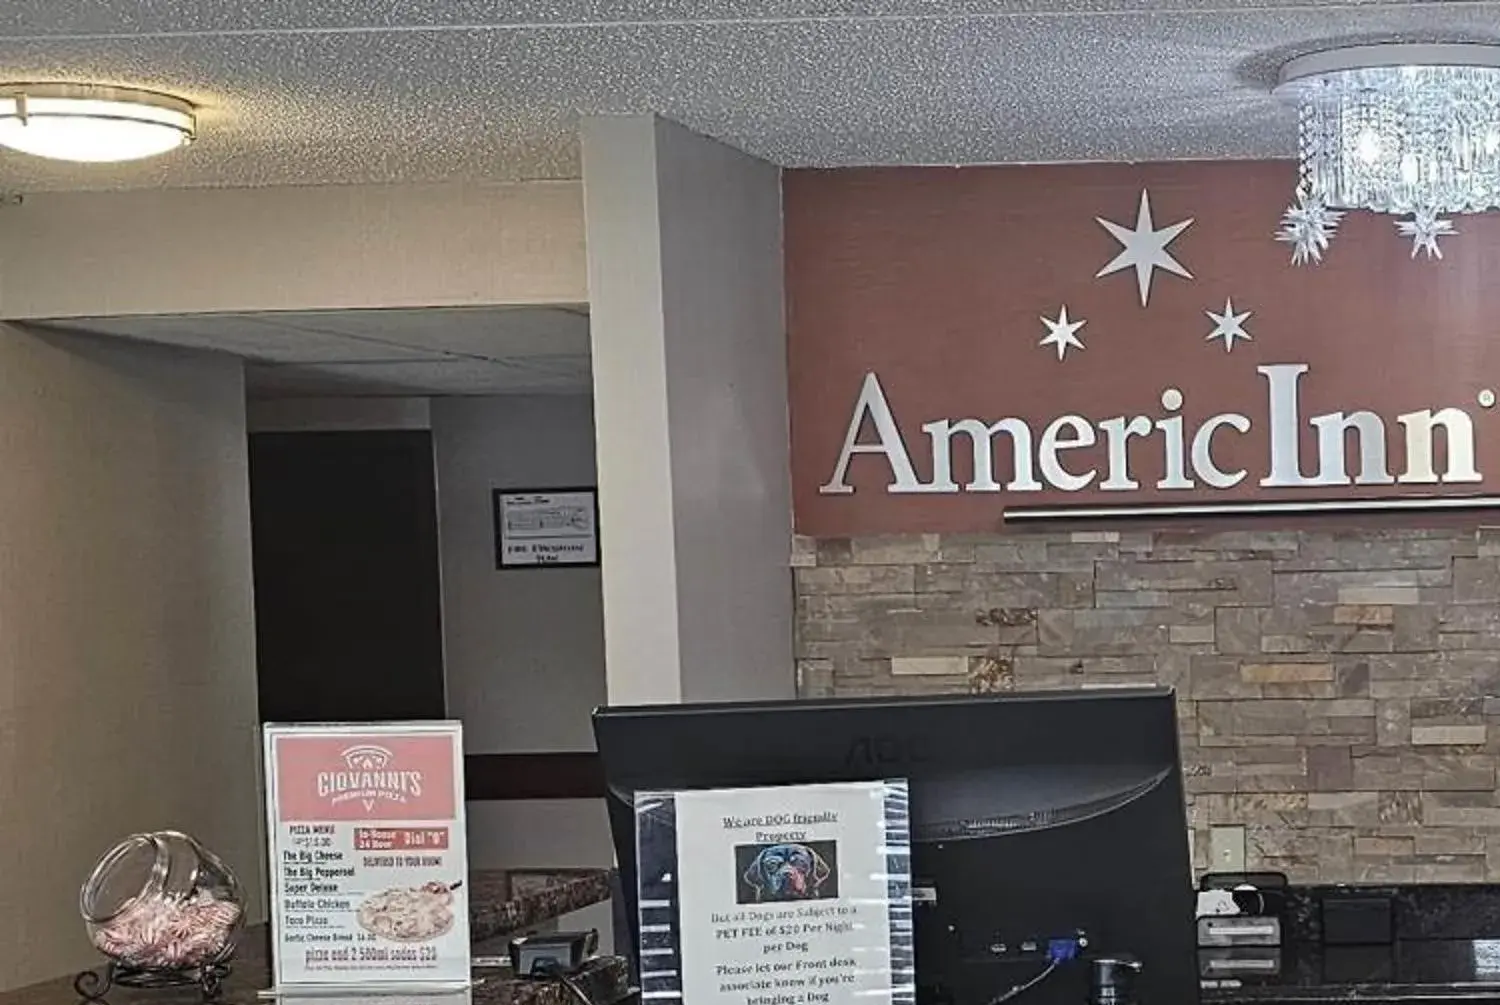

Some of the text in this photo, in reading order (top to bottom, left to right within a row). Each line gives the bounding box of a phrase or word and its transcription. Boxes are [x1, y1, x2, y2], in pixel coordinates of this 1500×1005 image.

[819, 363, 1484, 493] AmericInn
[317, 770, 421, 797] GIOVANNI'S
[743, 817, 765, 827] are
[765, 813, 791, 826] DOG
[283, 850, 343, 863] The Big Cheese
[283, 867, 297, 876] The
[299, 867, 312, 880] Big
[317, 899, 350, 909] Chicken
[749, 911, 774, 923] Dogs
[837, 905, 849, 915] to
[715, 928, 738, 939] PET
[802, 923, 822, 933] Per
[762, 941, 809, 954] per Dog
[715, 963, 753, 976] Please
[755, 961, 771, 973] let
[773, 962, 793, 972] our
[795, 959, 827, 971] Front
[719, 979, 773, 992] associate
[806, 991, 830, 1003] Dog
